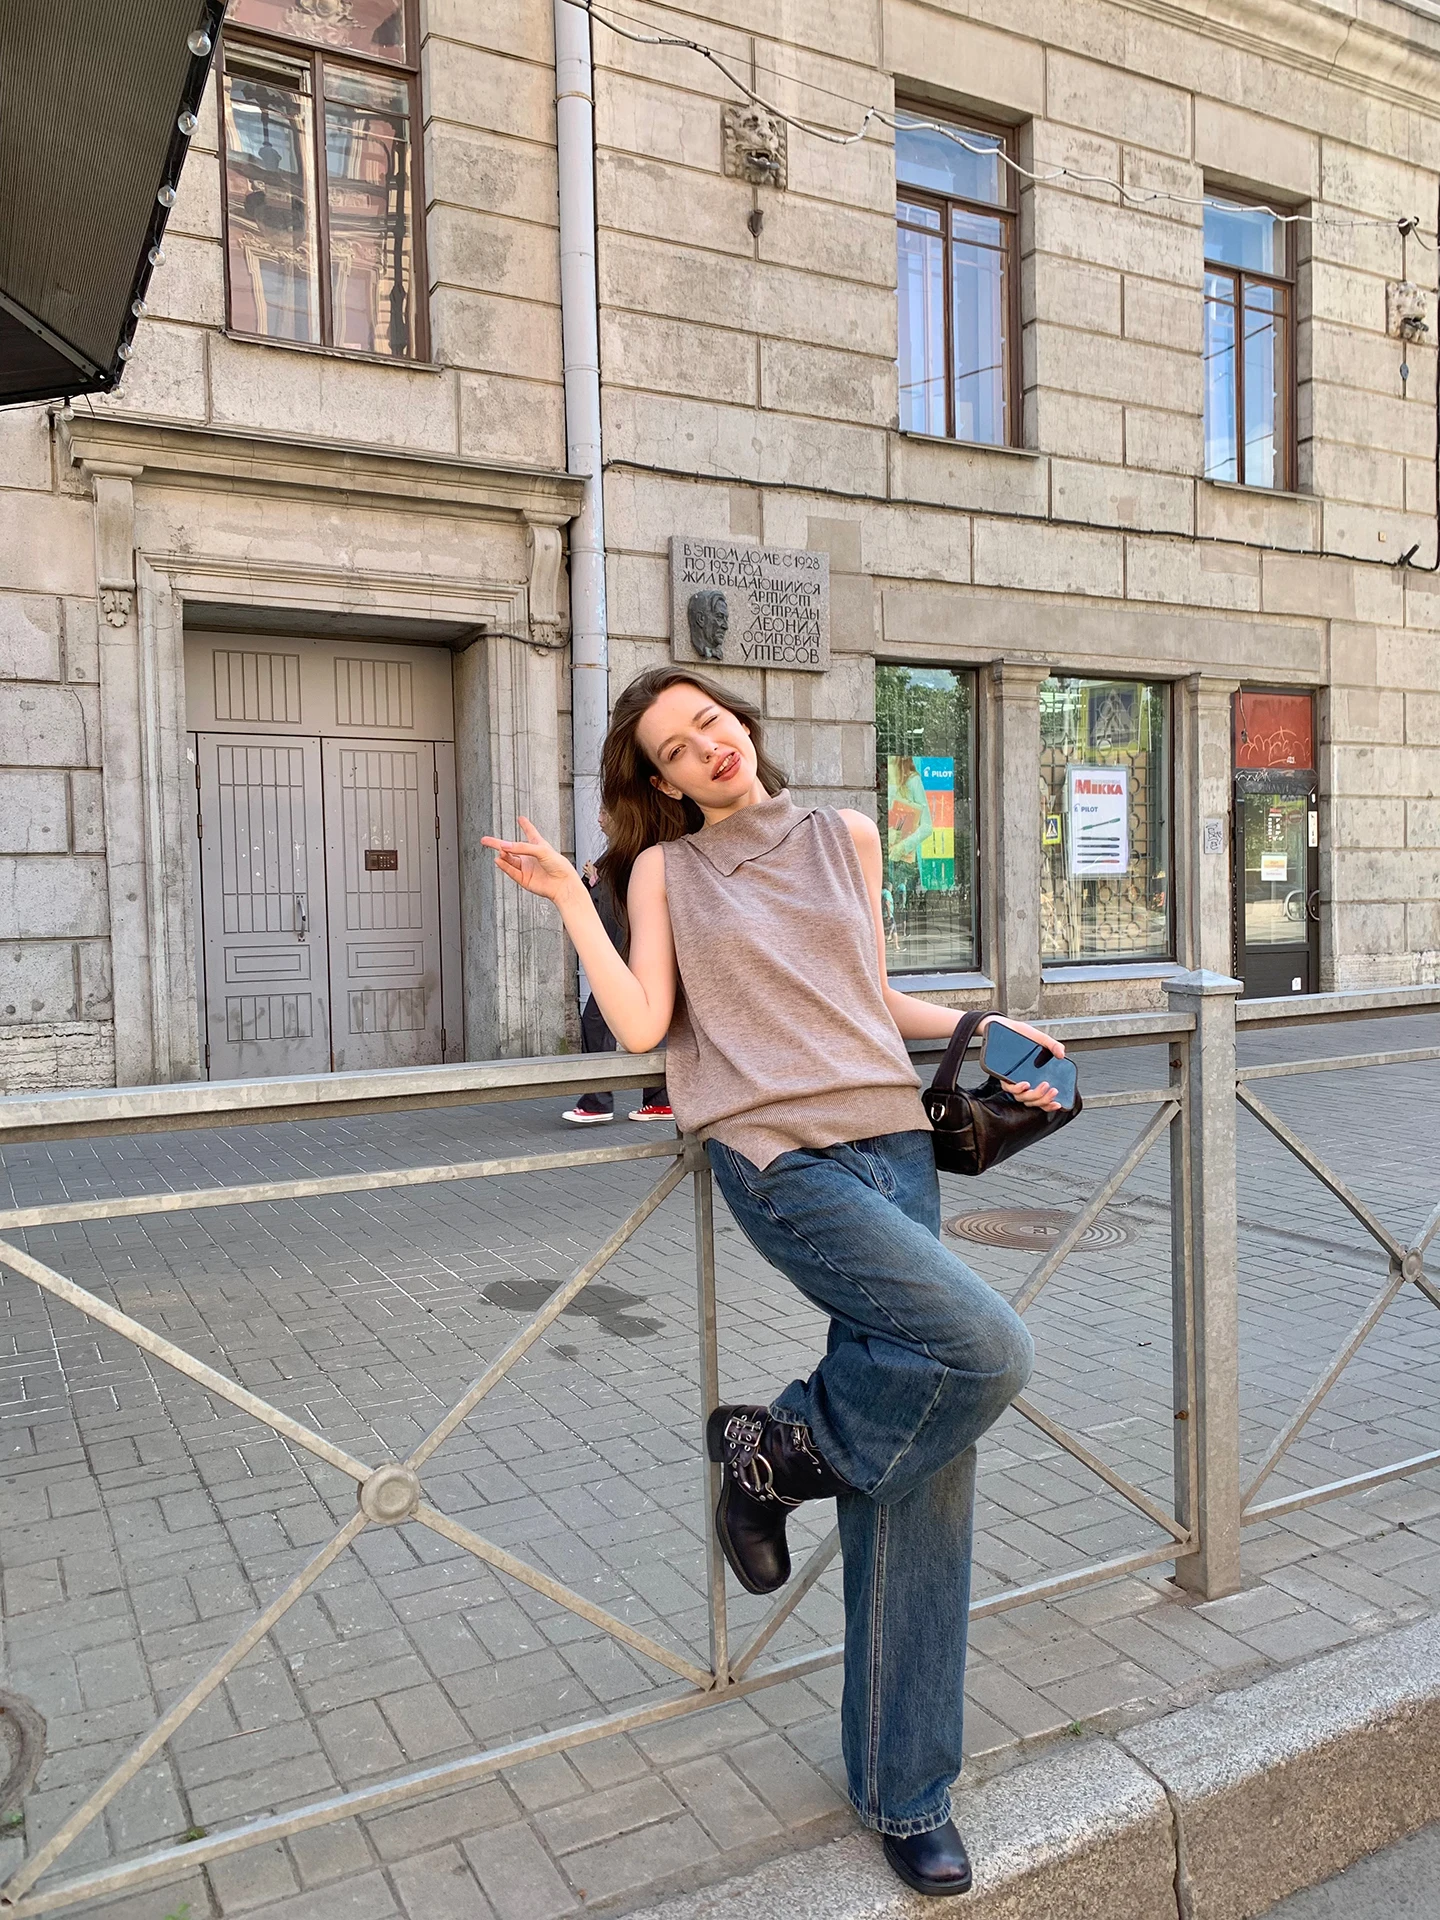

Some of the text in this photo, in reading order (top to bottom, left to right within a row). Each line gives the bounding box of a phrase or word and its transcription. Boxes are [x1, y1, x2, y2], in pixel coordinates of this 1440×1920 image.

[684, 544, 820, 570] В ЭТОМ ДОМЕ С 1928
[685, 557, 763, 577] ПО 1937 ГОД
[682, 570, 821, 595] ЖИЛ ВЫДАЮЩИЙСЯ
[748, 590, 811, 606] АРТИСТ
[750, 603, 820, 620] ЭСТРАДЫ
[750, 615, 821, 636] ЛЕОНИД
[742, 631, 820, 647] ОСИПОВИЧ
[740, 643, 820, 664] УТЕСОВ
[931, 770, 953, 778] PILOT
